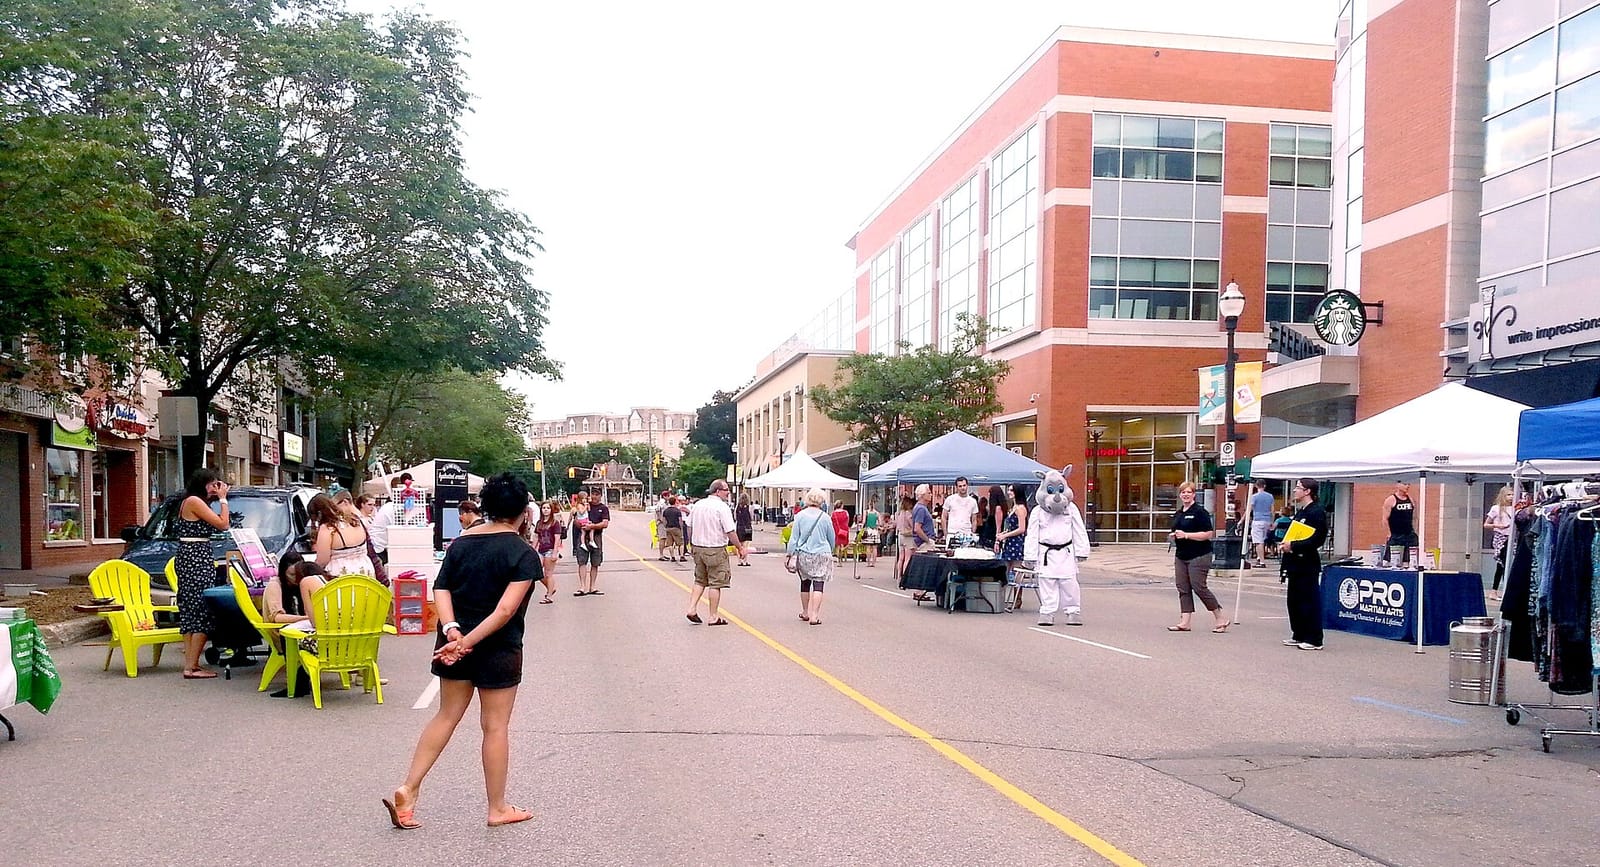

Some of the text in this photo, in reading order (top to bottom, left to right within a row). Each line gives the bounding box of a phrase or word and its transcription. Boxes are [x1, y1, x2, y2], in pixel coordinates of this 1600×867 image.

[1508, 330, 1533, 344] write
[1360, 580, 1405, 607] PRO
[1360, 603, 1404, 617] MARTIAL ARTS
